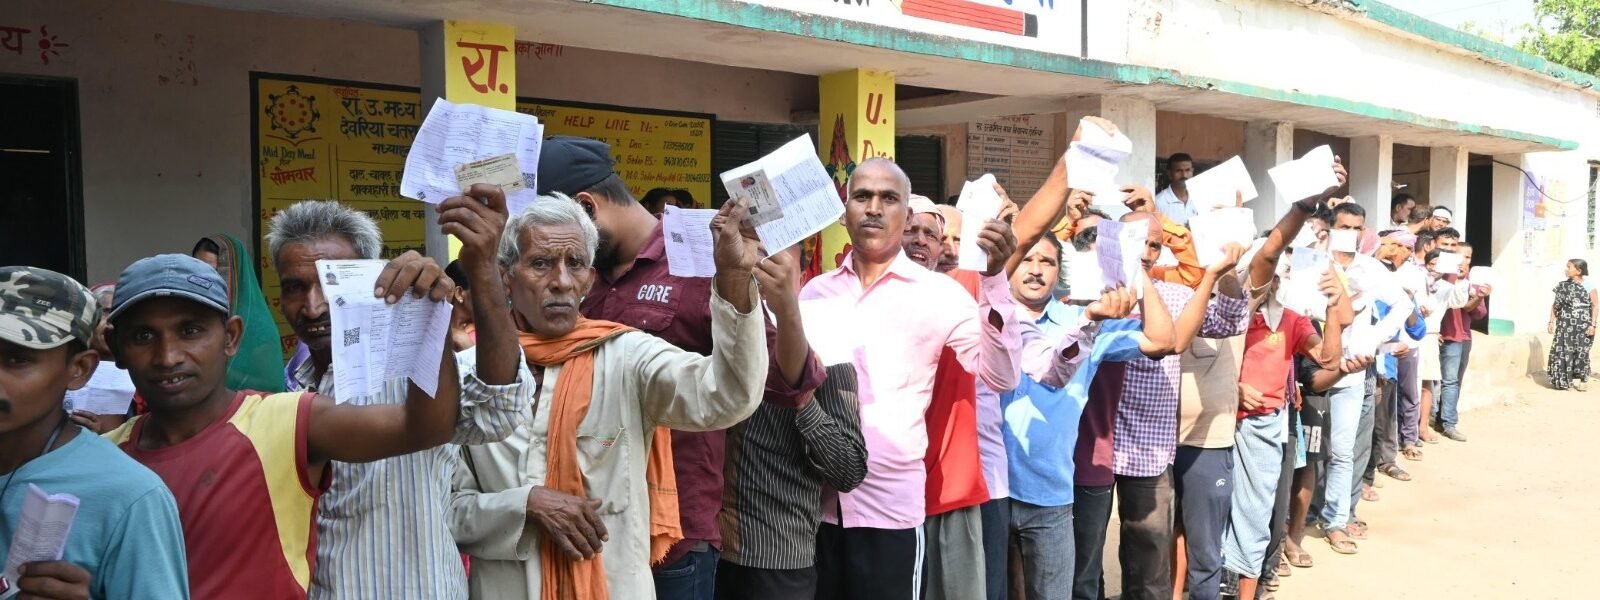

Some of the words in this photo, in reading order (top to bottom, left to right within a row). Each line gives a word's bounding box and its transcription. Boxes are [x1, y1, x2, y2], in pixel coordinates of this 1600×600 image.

[456, 41, 508, 94] रा.
[364, 99, 383, 116] उ.
[383, 101, 417, 119] मध्य
[865, 93, 887, 125] U.
[340, 115, 385, 138] देवरिया
[563, 115, 595, 129] HELP
[605, 118, 631, 131] LINE
[263, 146, 279, 158] Mid
[270, 166, 317, 186] सोमवार
[36, 299, 52, 307] ZEE
[637, 284, 674, 304] CORE
